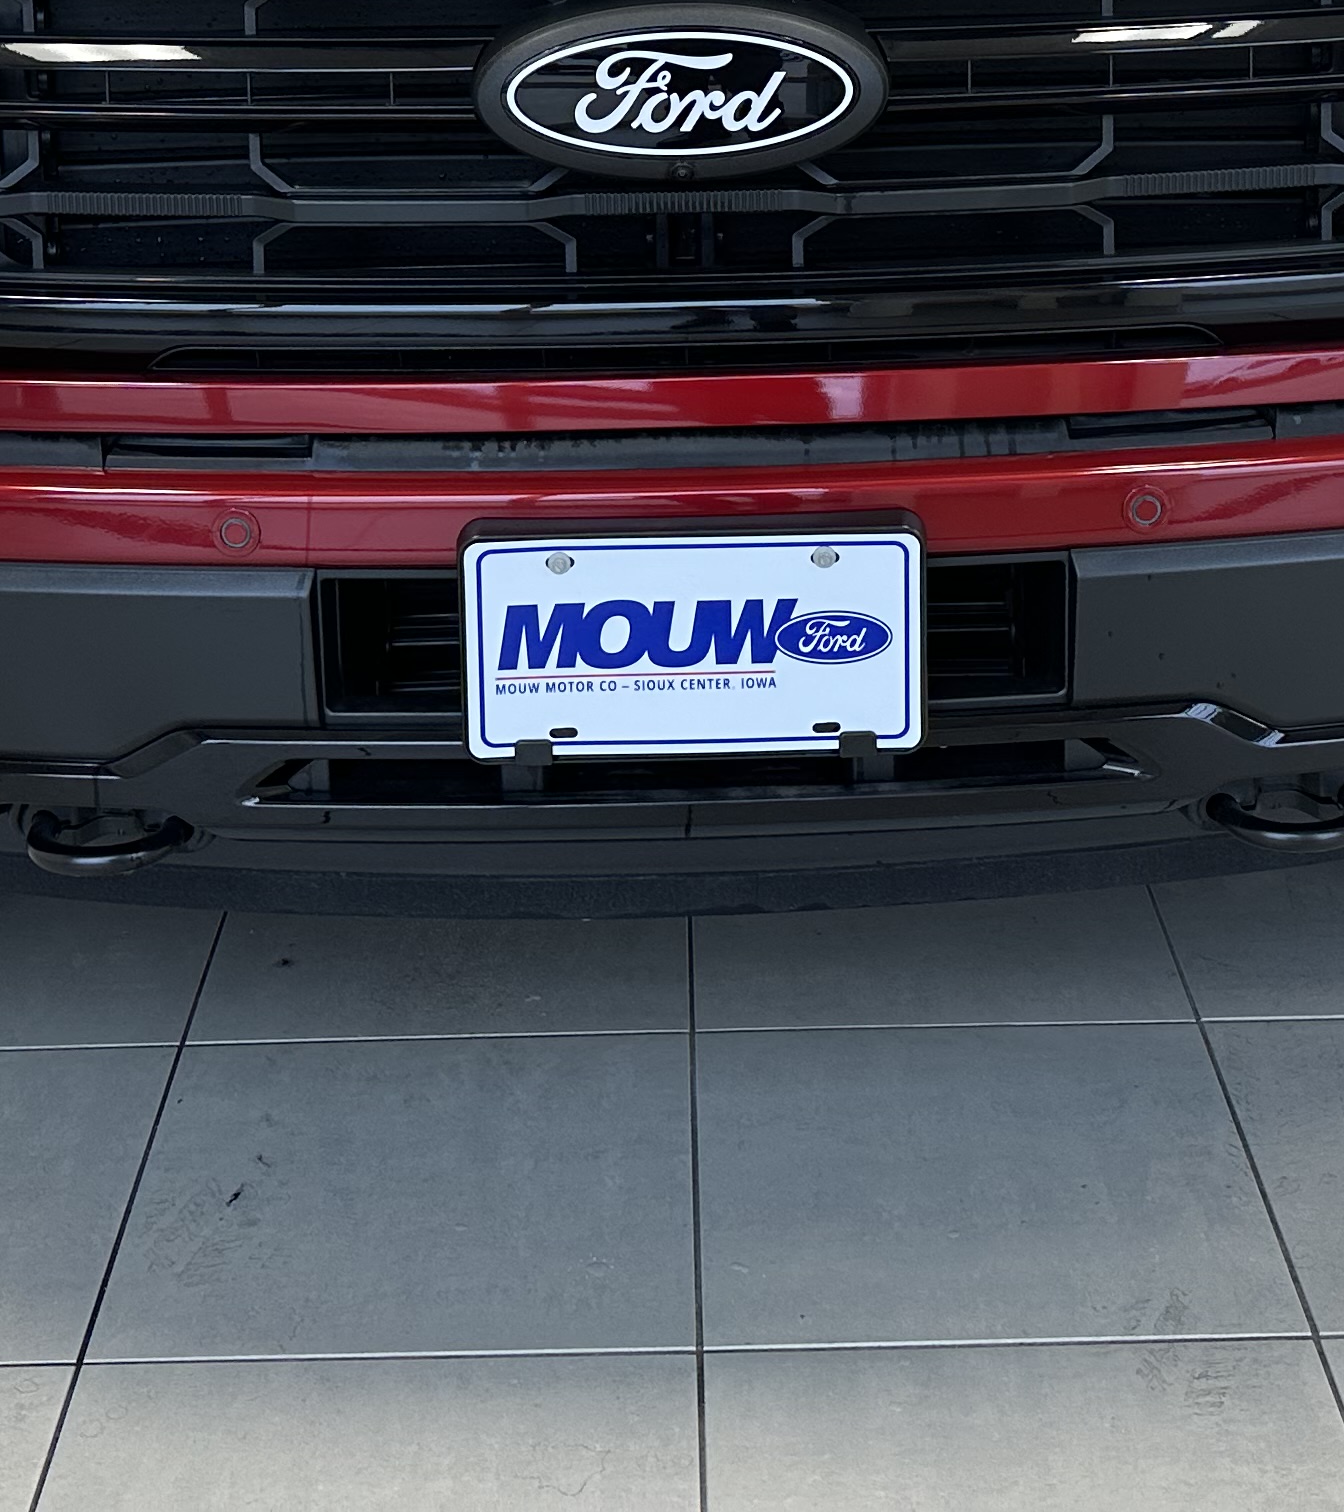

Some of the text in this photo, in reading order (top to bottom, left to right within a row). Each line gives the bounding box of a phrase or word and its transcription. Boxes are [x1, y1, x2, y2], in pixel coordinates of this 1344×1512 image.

[574, 50, 787, 134] Ford
[497, 597, 799, 671] MOUW
[798, 618, 867, 654] Ford
[495, 682, 541, 696] MOUW
[545, 680, 595, 694] MOTOR
[599, 680, 617, 692] CO
[633, 678, 676, 692] SIOUX
[740, 676, 777, 690] IOWA
